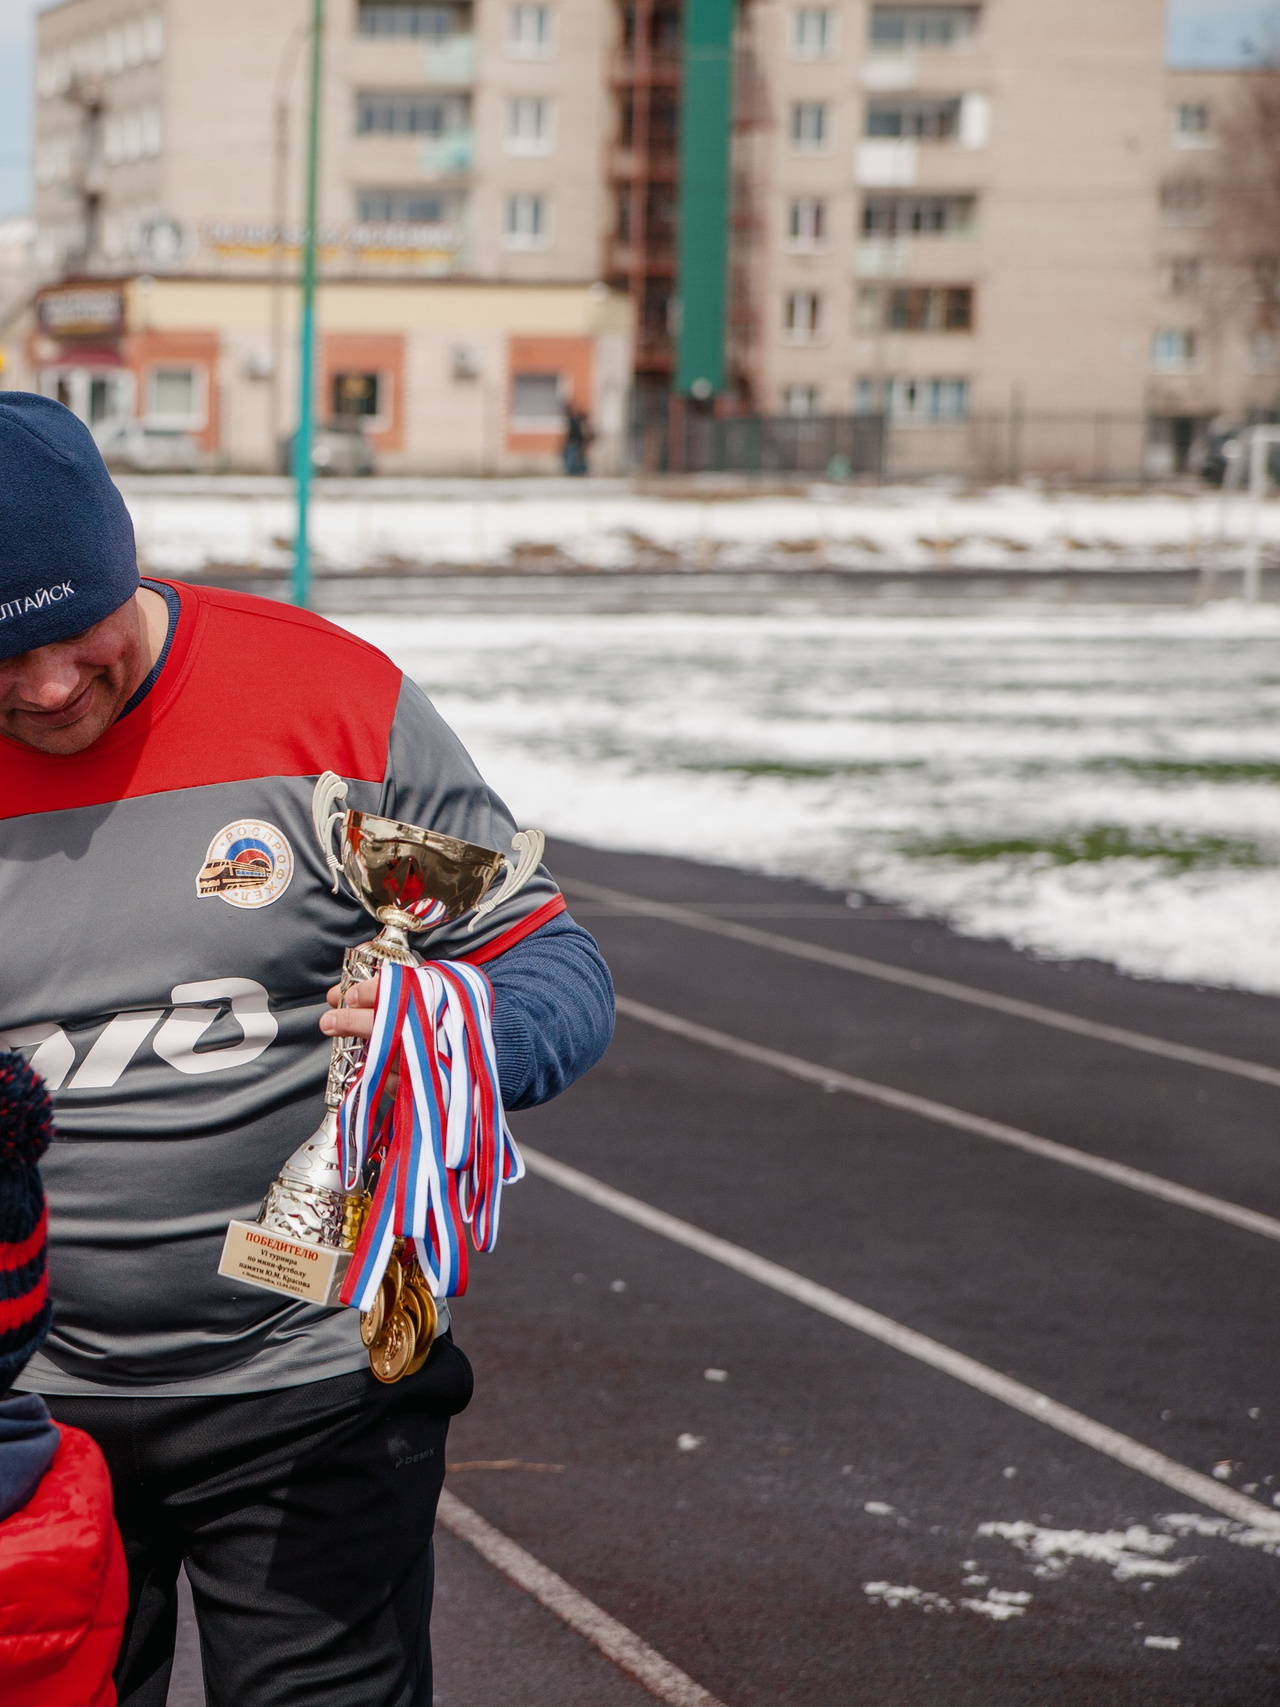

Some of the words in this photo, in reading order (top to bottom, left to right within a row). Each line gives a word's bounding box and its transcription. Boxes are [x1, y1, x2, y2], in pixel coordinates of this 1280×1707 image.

[224, 826, 286, 901] РОСПРОФЖЕЛ
[245, 1232, 319, 1261] ПОБЕДИТЕЛЮ
[261, 1249, 269, 1257] VI
[269, 1252, 298, 1266] турнира
[238, 1262, 264, 1274] памяти
[265, 1269, 281, 1279] Ю.М.
[282, 1274, 311, 1289] Красова
[247, 1255, 256, 1263] по
[257, 1258, 307, 1279] мини-футболу
